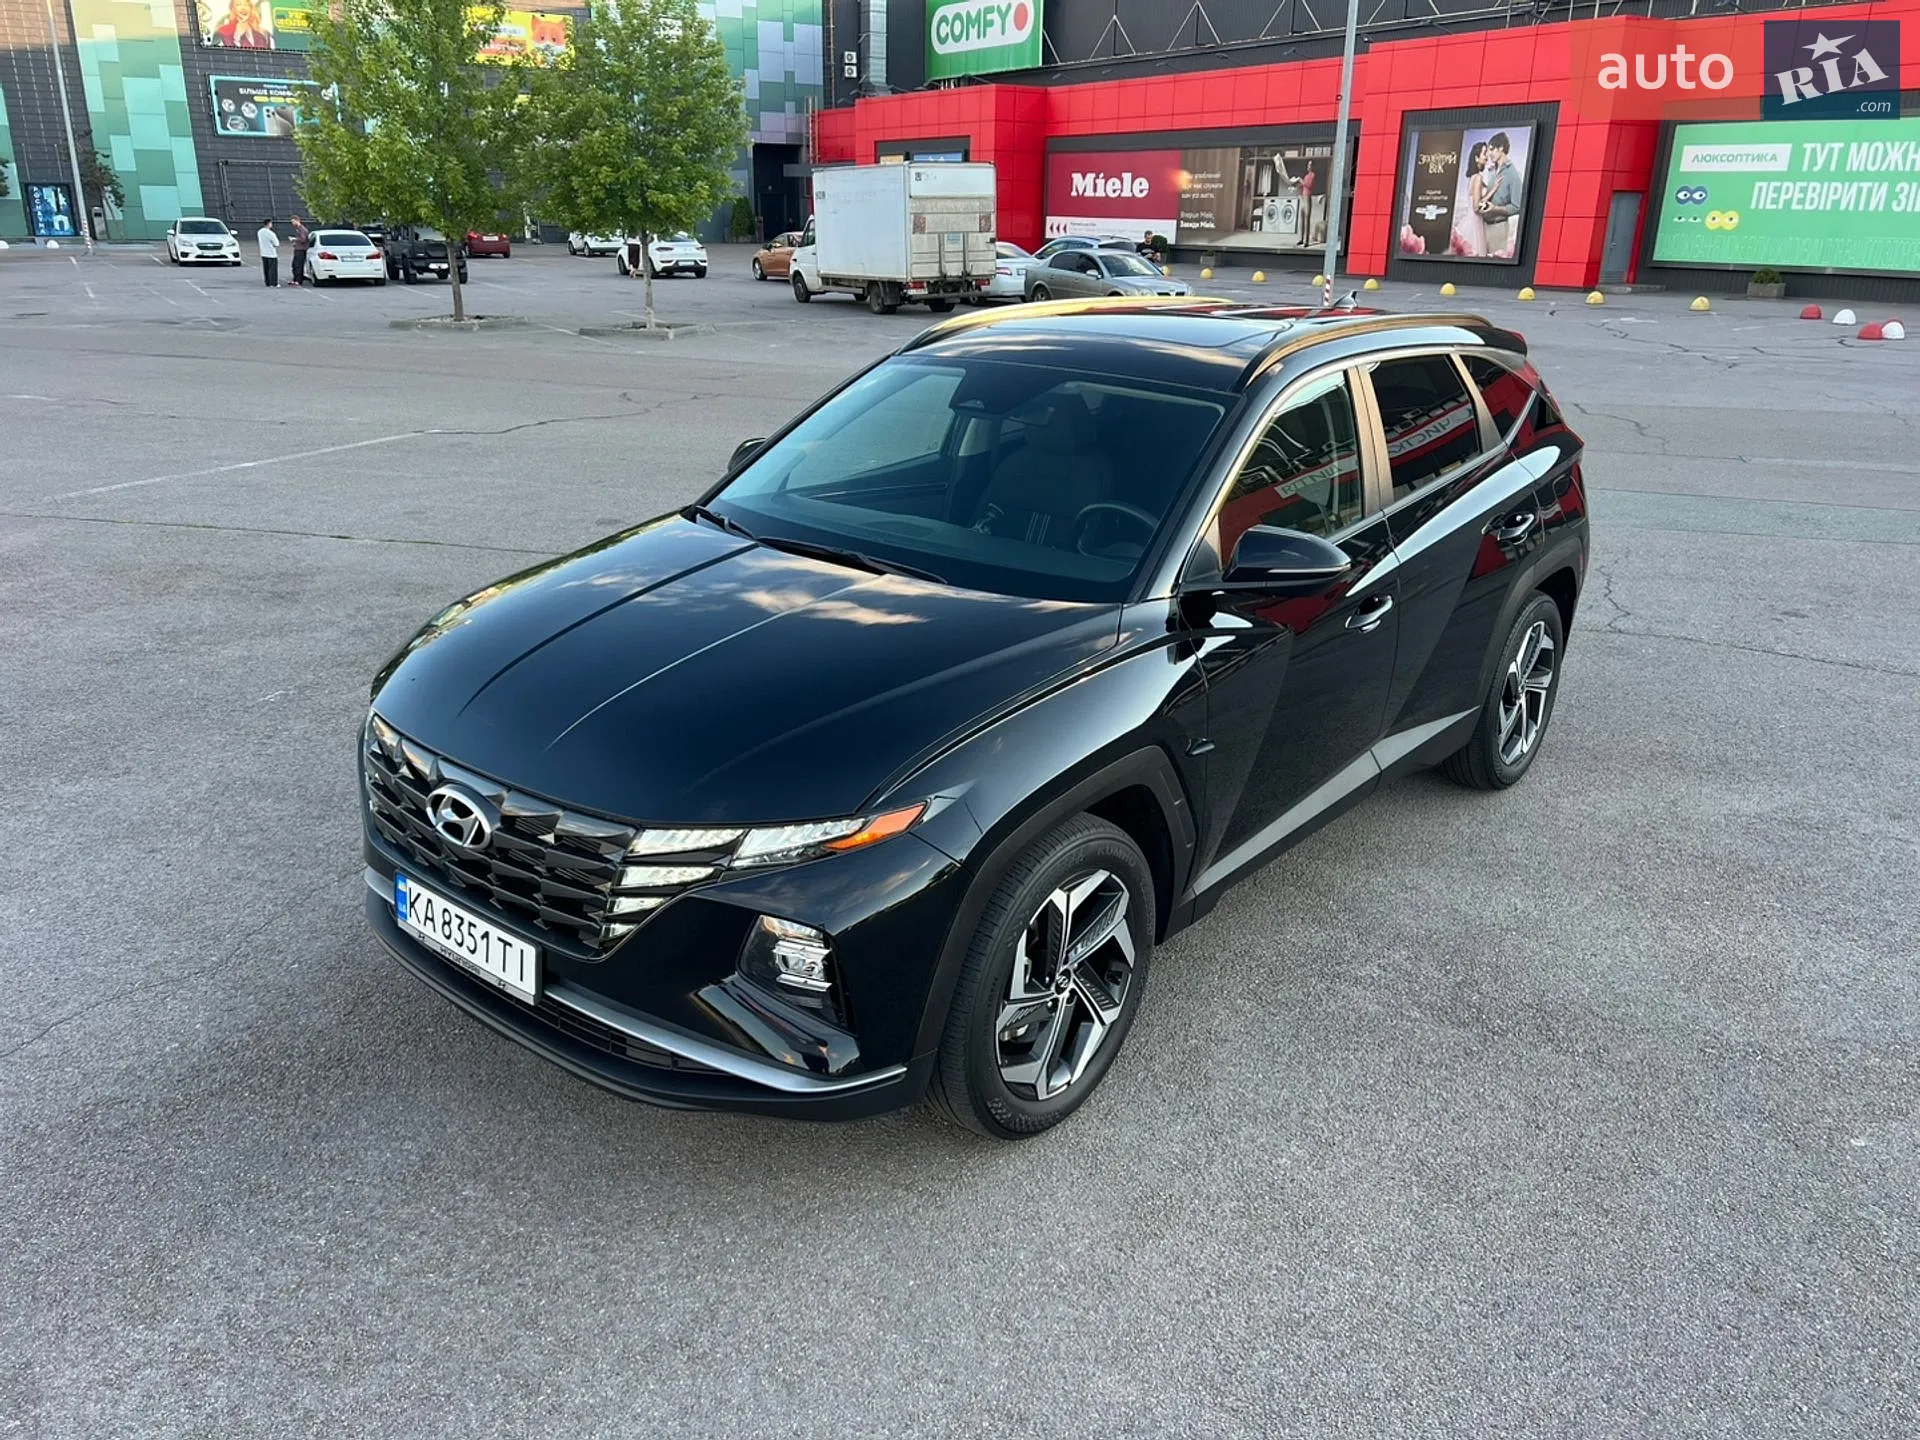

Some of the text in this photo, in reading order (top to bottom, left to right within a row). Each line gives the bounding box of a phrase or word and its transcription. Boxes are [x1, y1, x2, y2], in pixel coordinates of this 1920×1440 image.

[936, 2, 1012, 45] COMFY
[1692, 152, 1778, 164] ЛЮКСОПТИКА
[1802, 140, 1920, 172] ТУТ МОЖН
[1071, 171, 1150, 198] Miele
[1750, 181, 1889, 212] ПЕРЕВІРИТИ
[409, 887, 524, 982] KA 8351 TI
